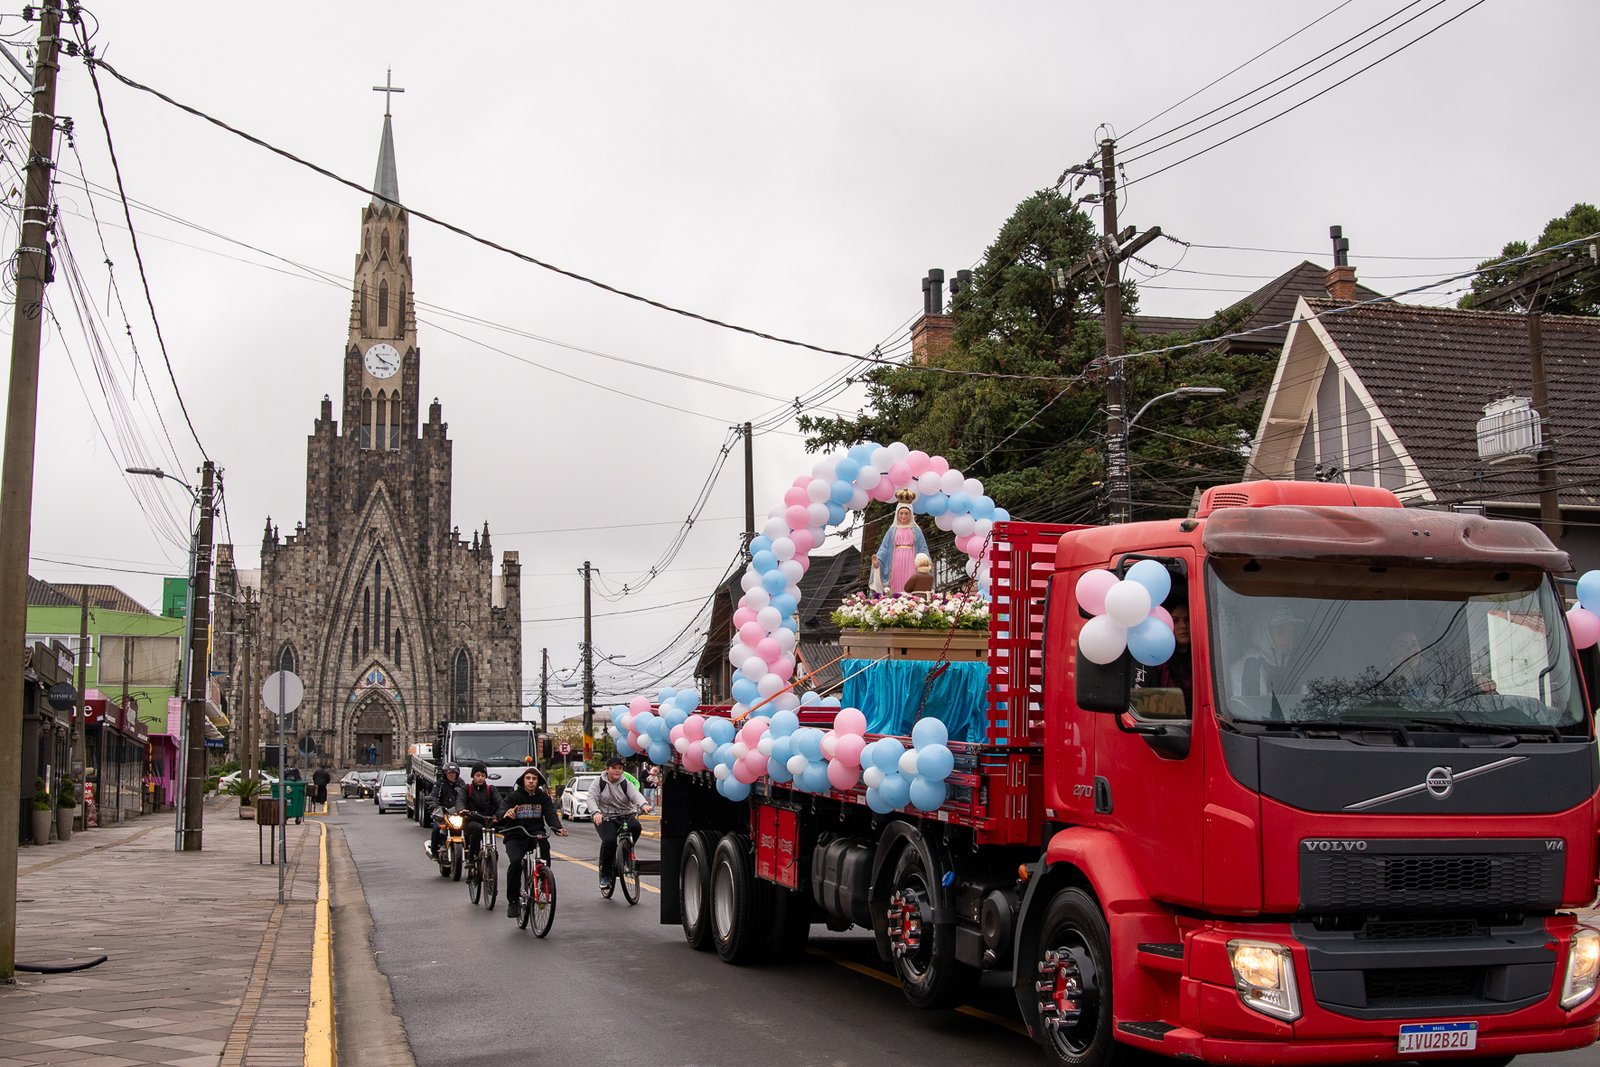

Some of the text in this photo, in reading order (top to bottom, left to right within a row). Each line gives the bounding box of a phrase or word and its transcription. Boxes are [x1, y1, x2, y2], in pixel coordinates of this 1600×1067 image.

[1073, 784, 1093, 798] 270
[1303, 840, 1368, 851] VOLVO
[1545, 840, 1564, 851] VM
[1407, 1031, 1469, 1050] IVU2B20
